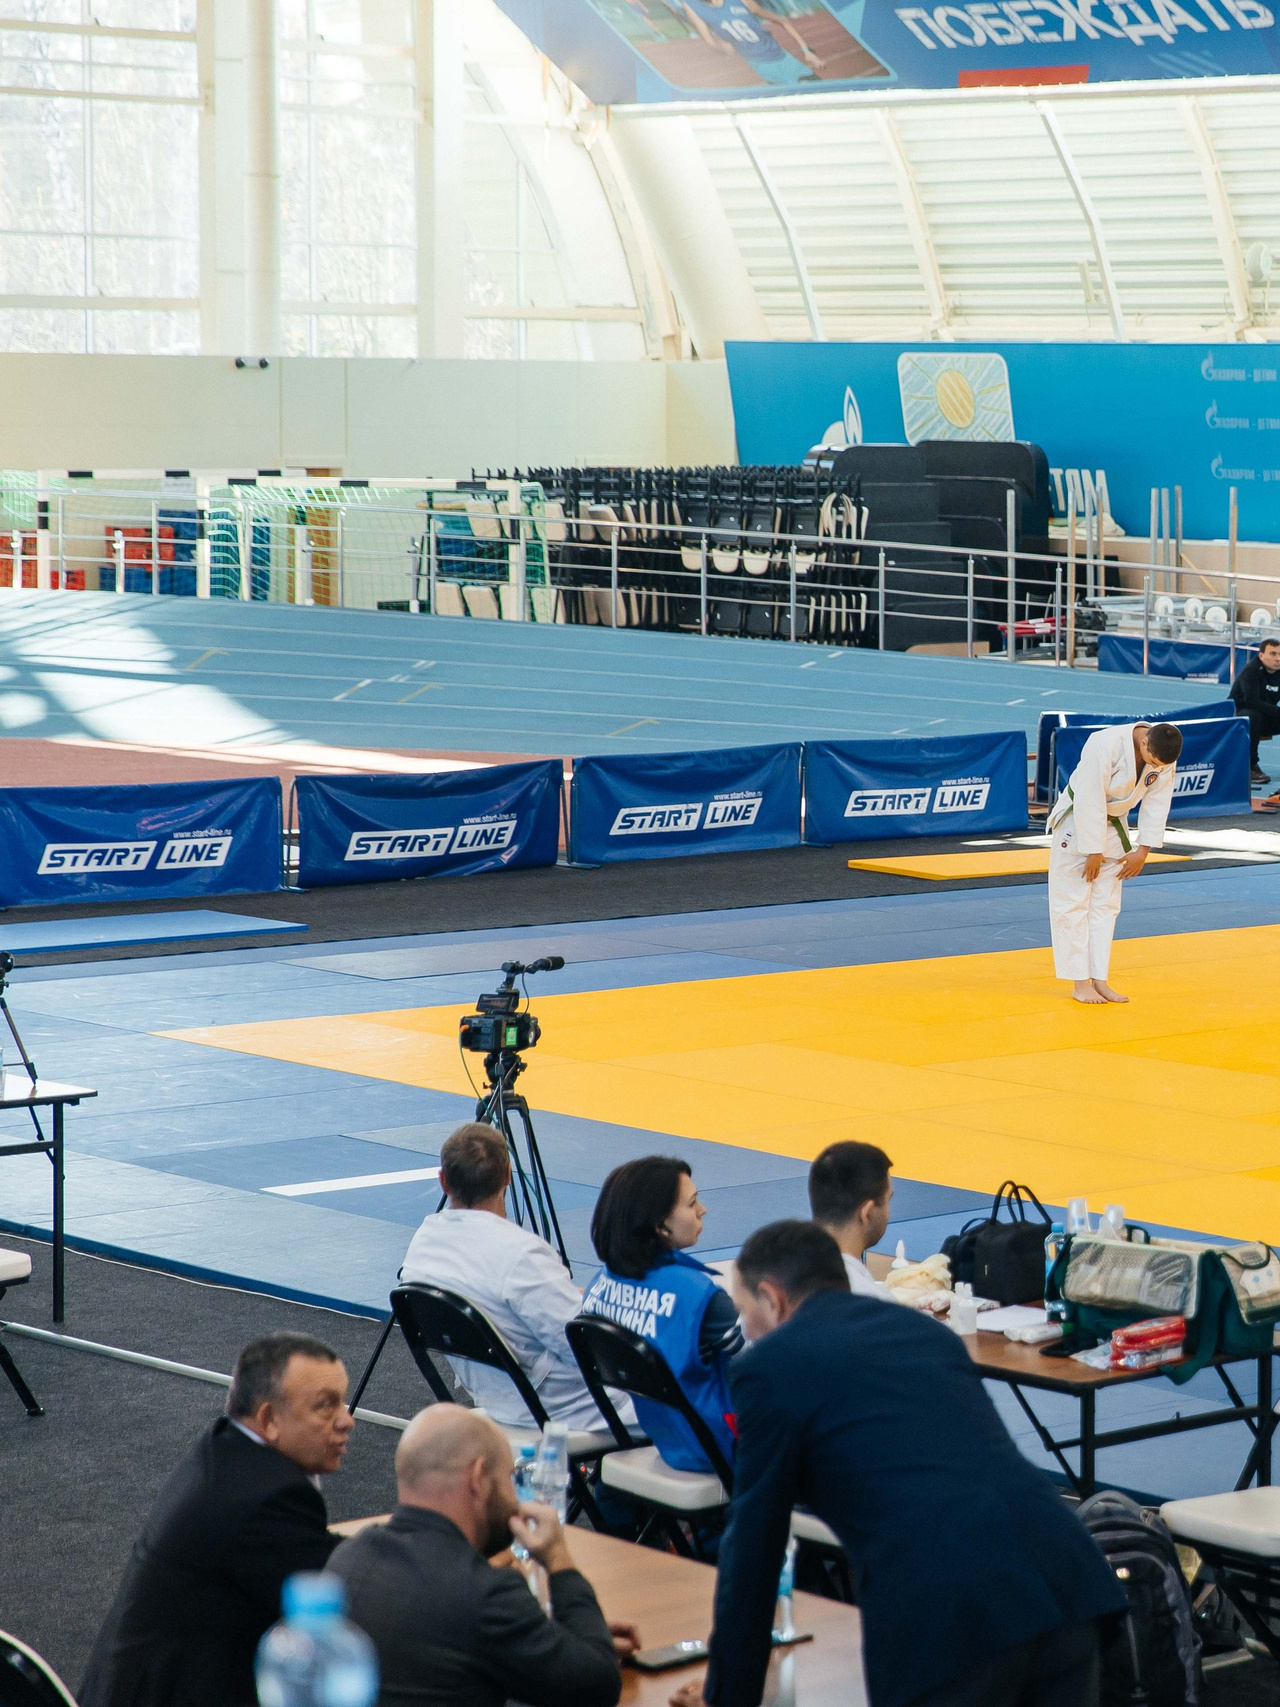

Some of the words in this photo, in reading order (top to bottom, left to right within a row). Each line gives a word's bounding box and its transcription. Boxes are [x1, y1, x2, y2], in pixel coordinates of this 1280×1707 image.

[942, 777, 990, 786] www.start-line.ru
[1174, 774, 1208, 792] INE
[714, 790, 763, 800] www.start-line.ru
[851, 792, 926, 812] START
[938, 789, 983, 808] LINE
[617, 808, 697, 830] START
[709, 804, 754, 824] LINE
[353, 833, 448, 855] START
[456, 826, 508, 848] LINE
[46, 846, 149, 868] START
[164, 842, 222, 864] LINE
